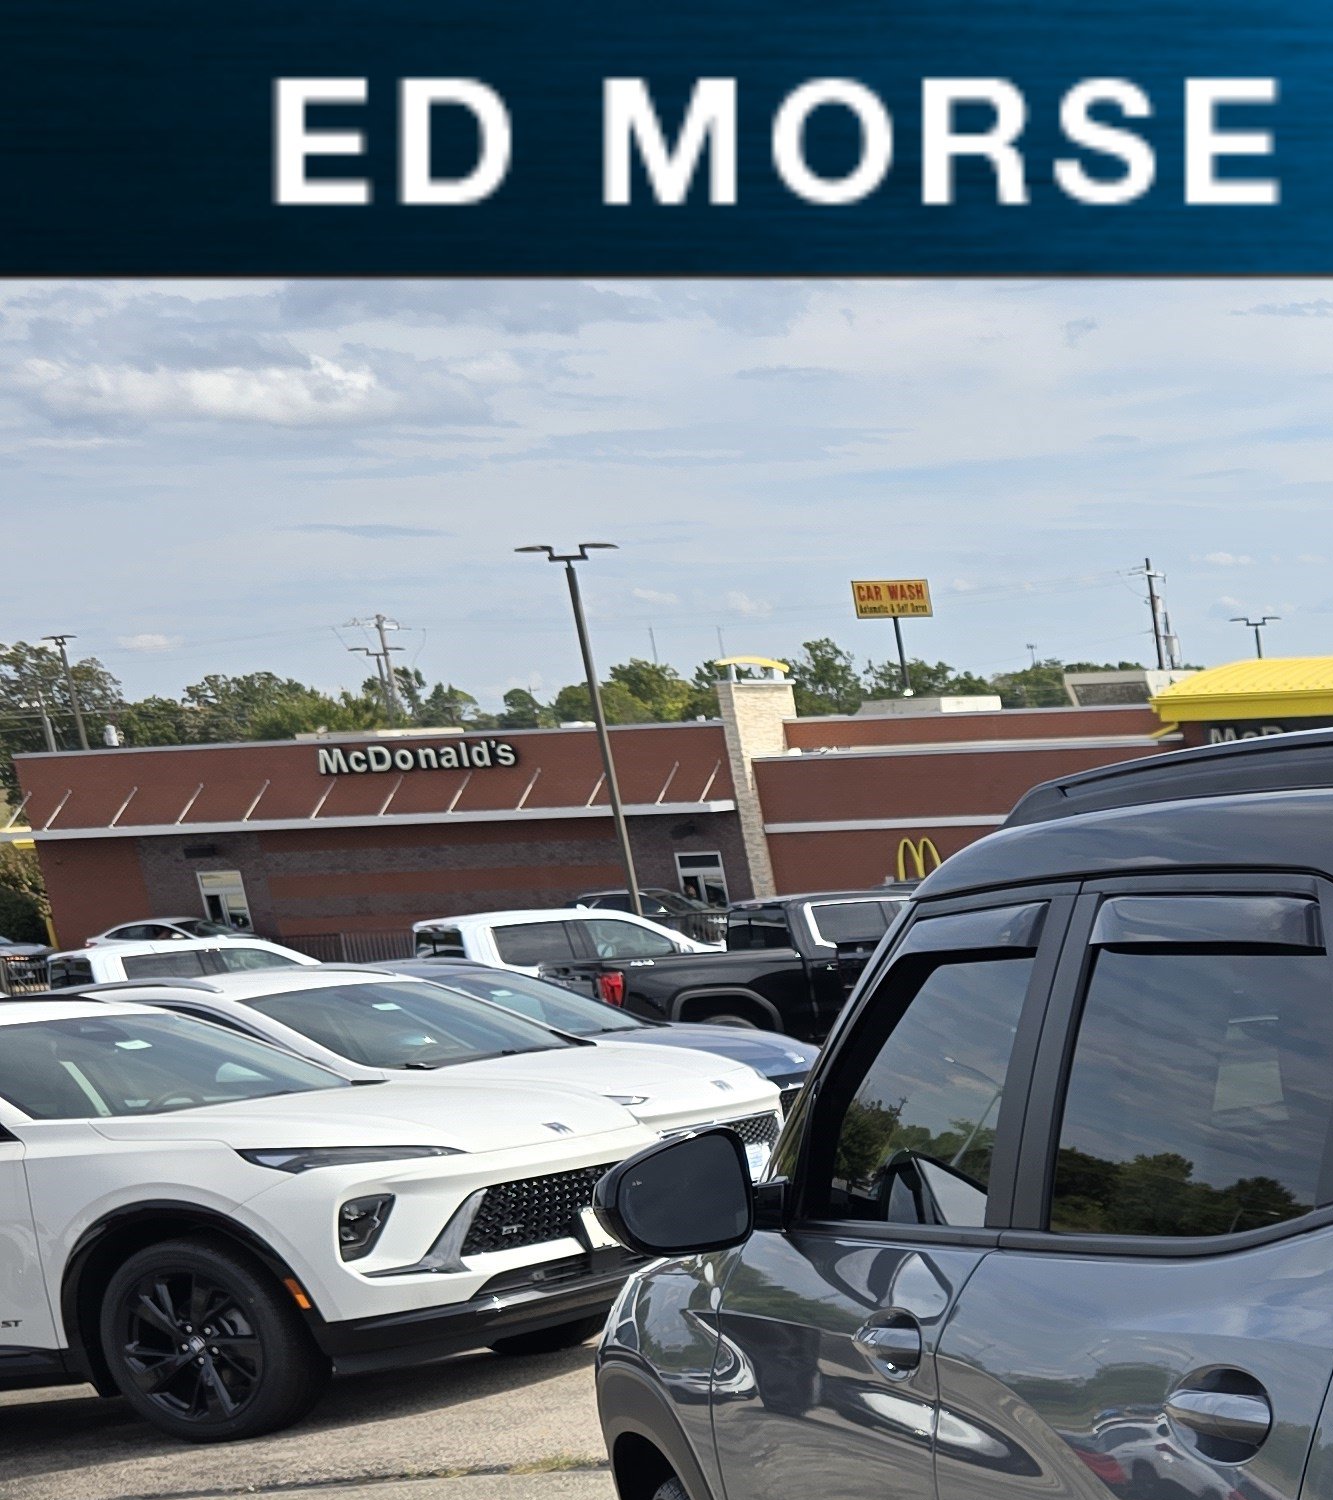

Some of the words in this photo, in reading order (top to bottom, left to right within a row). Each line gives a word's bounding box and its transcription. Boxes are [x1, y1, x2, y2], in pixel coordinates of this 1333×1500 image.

[856, 585, 882, 602] CAR
[887, 582, 924, 601] WASH
[318, 740, 516, 775] McDonald's
